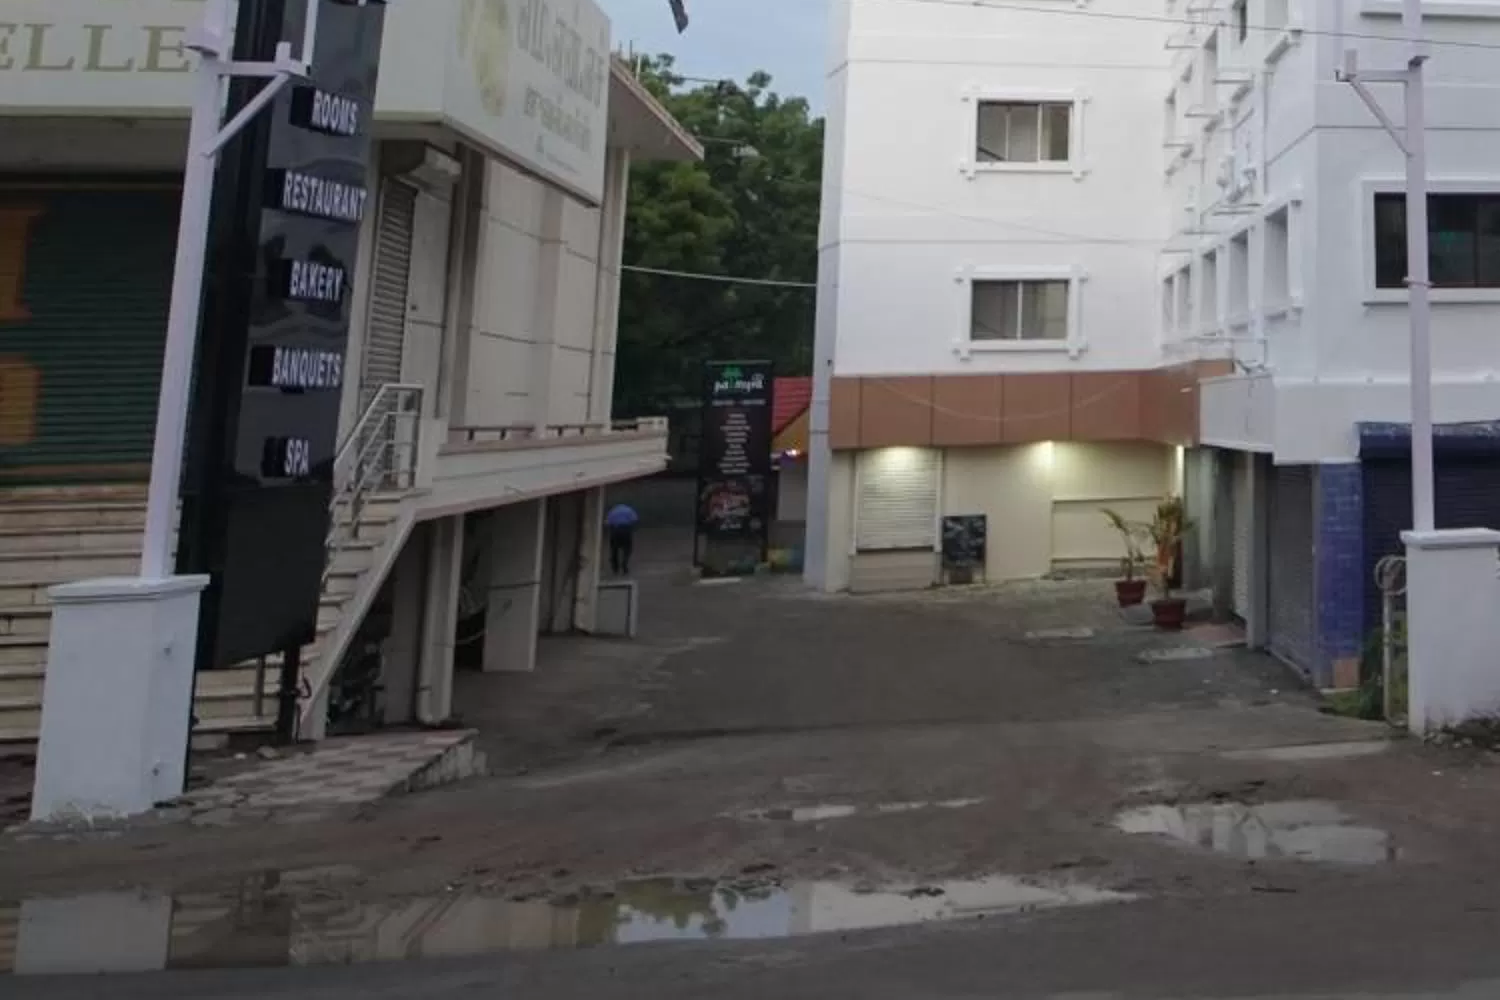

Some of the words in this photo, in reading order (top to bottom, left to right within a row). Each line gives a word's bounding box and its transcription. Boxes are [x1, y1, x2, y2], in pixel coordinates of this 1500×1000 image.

[312, 88, 358, 136] ROOMS
[283, 170, 367, 221] RESTAURANT
[289, 260, 343, 301] BAKERY
[272, 346, 342, 387] BANQUETS
[284, 438, 310, 476] SPA
